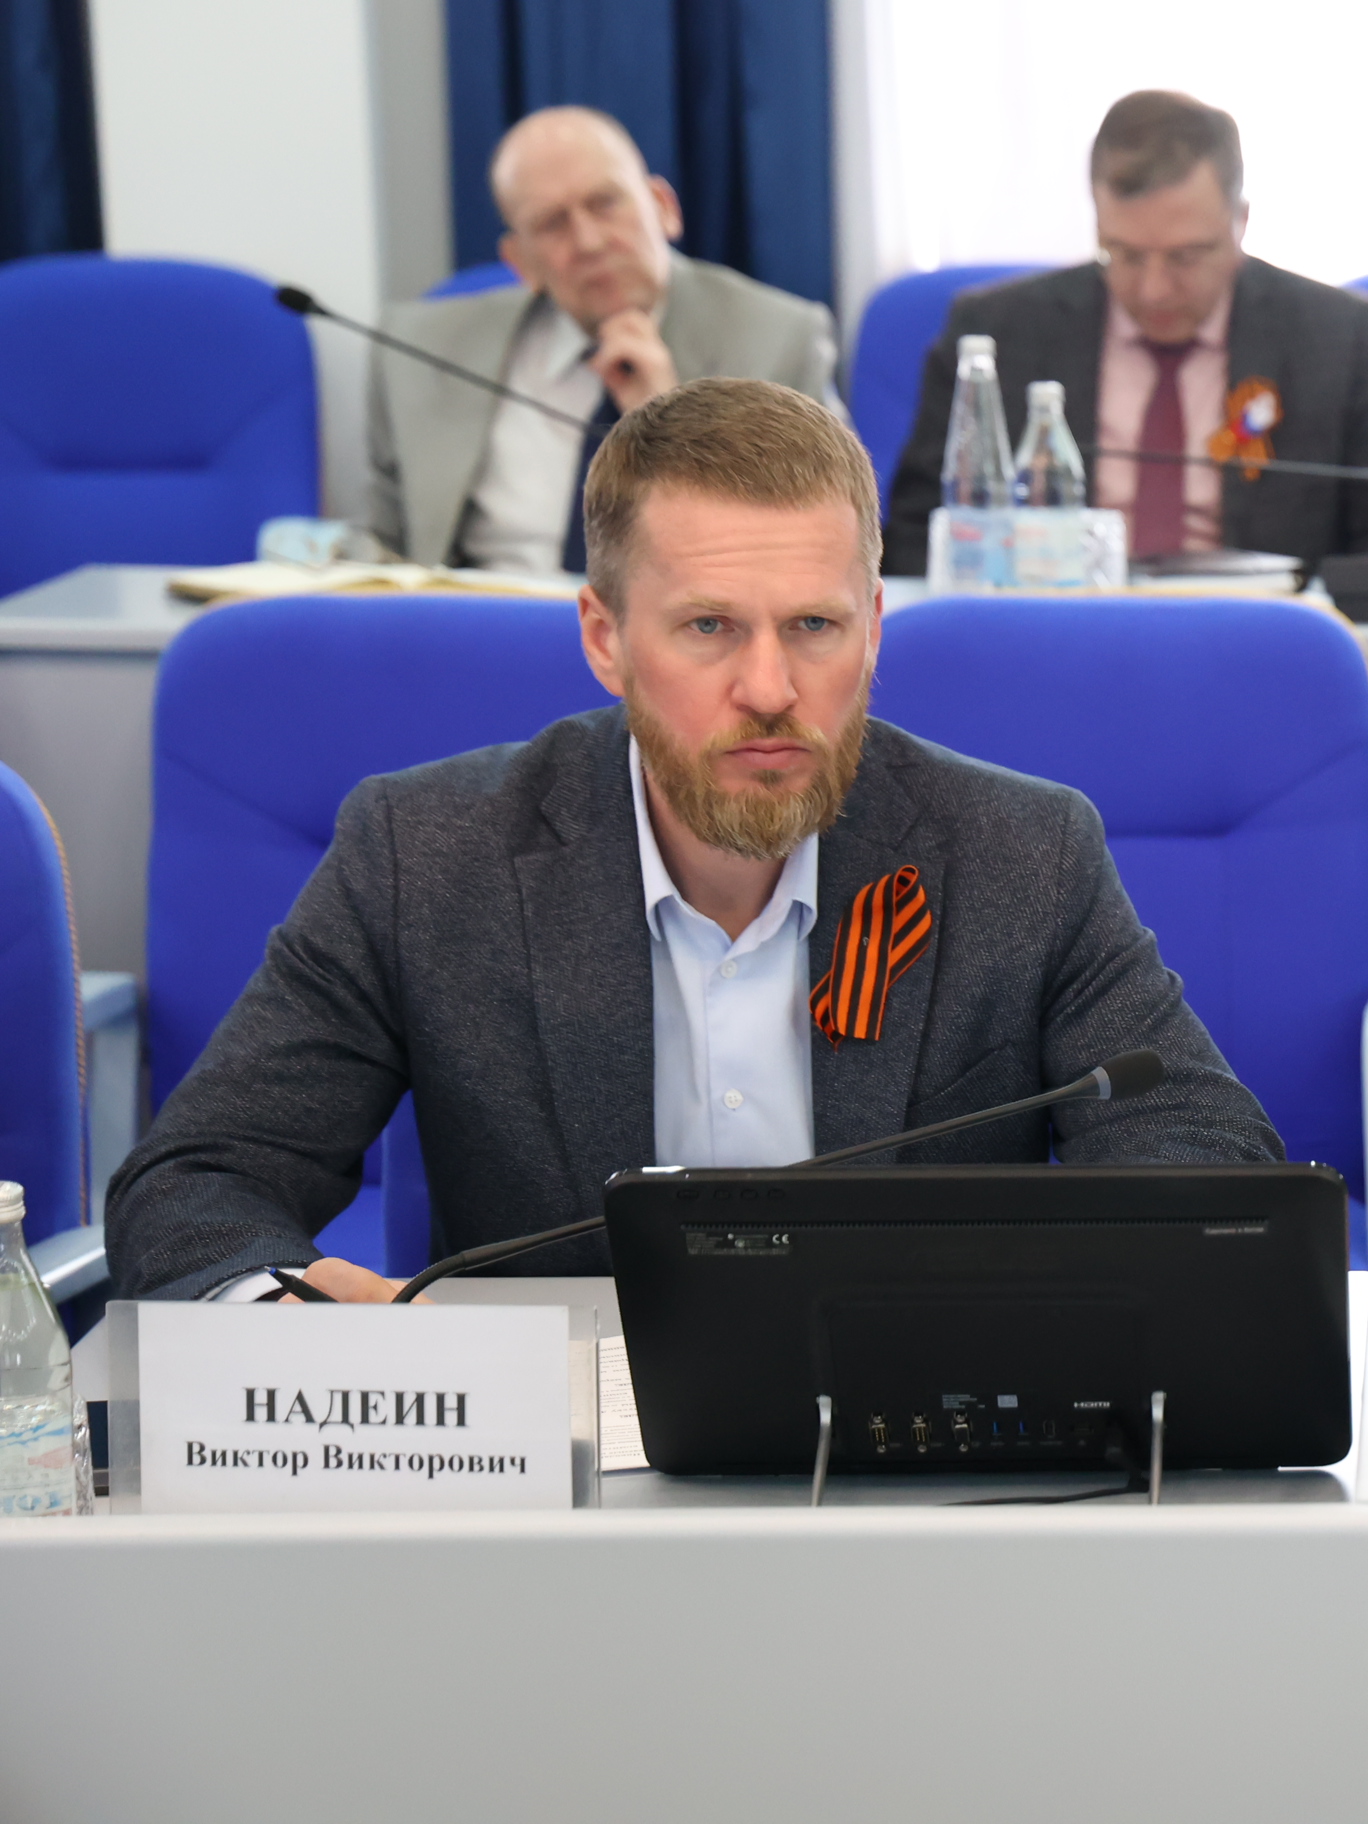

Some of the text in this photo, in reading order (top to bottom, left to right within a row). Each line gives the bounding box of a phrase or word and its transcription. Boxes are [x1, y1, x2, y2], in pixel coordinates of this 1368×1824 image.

[243, 1387, 470, 1432] НАДЕИН
[185, 1440, 527, 1480] Виктор Викторович
